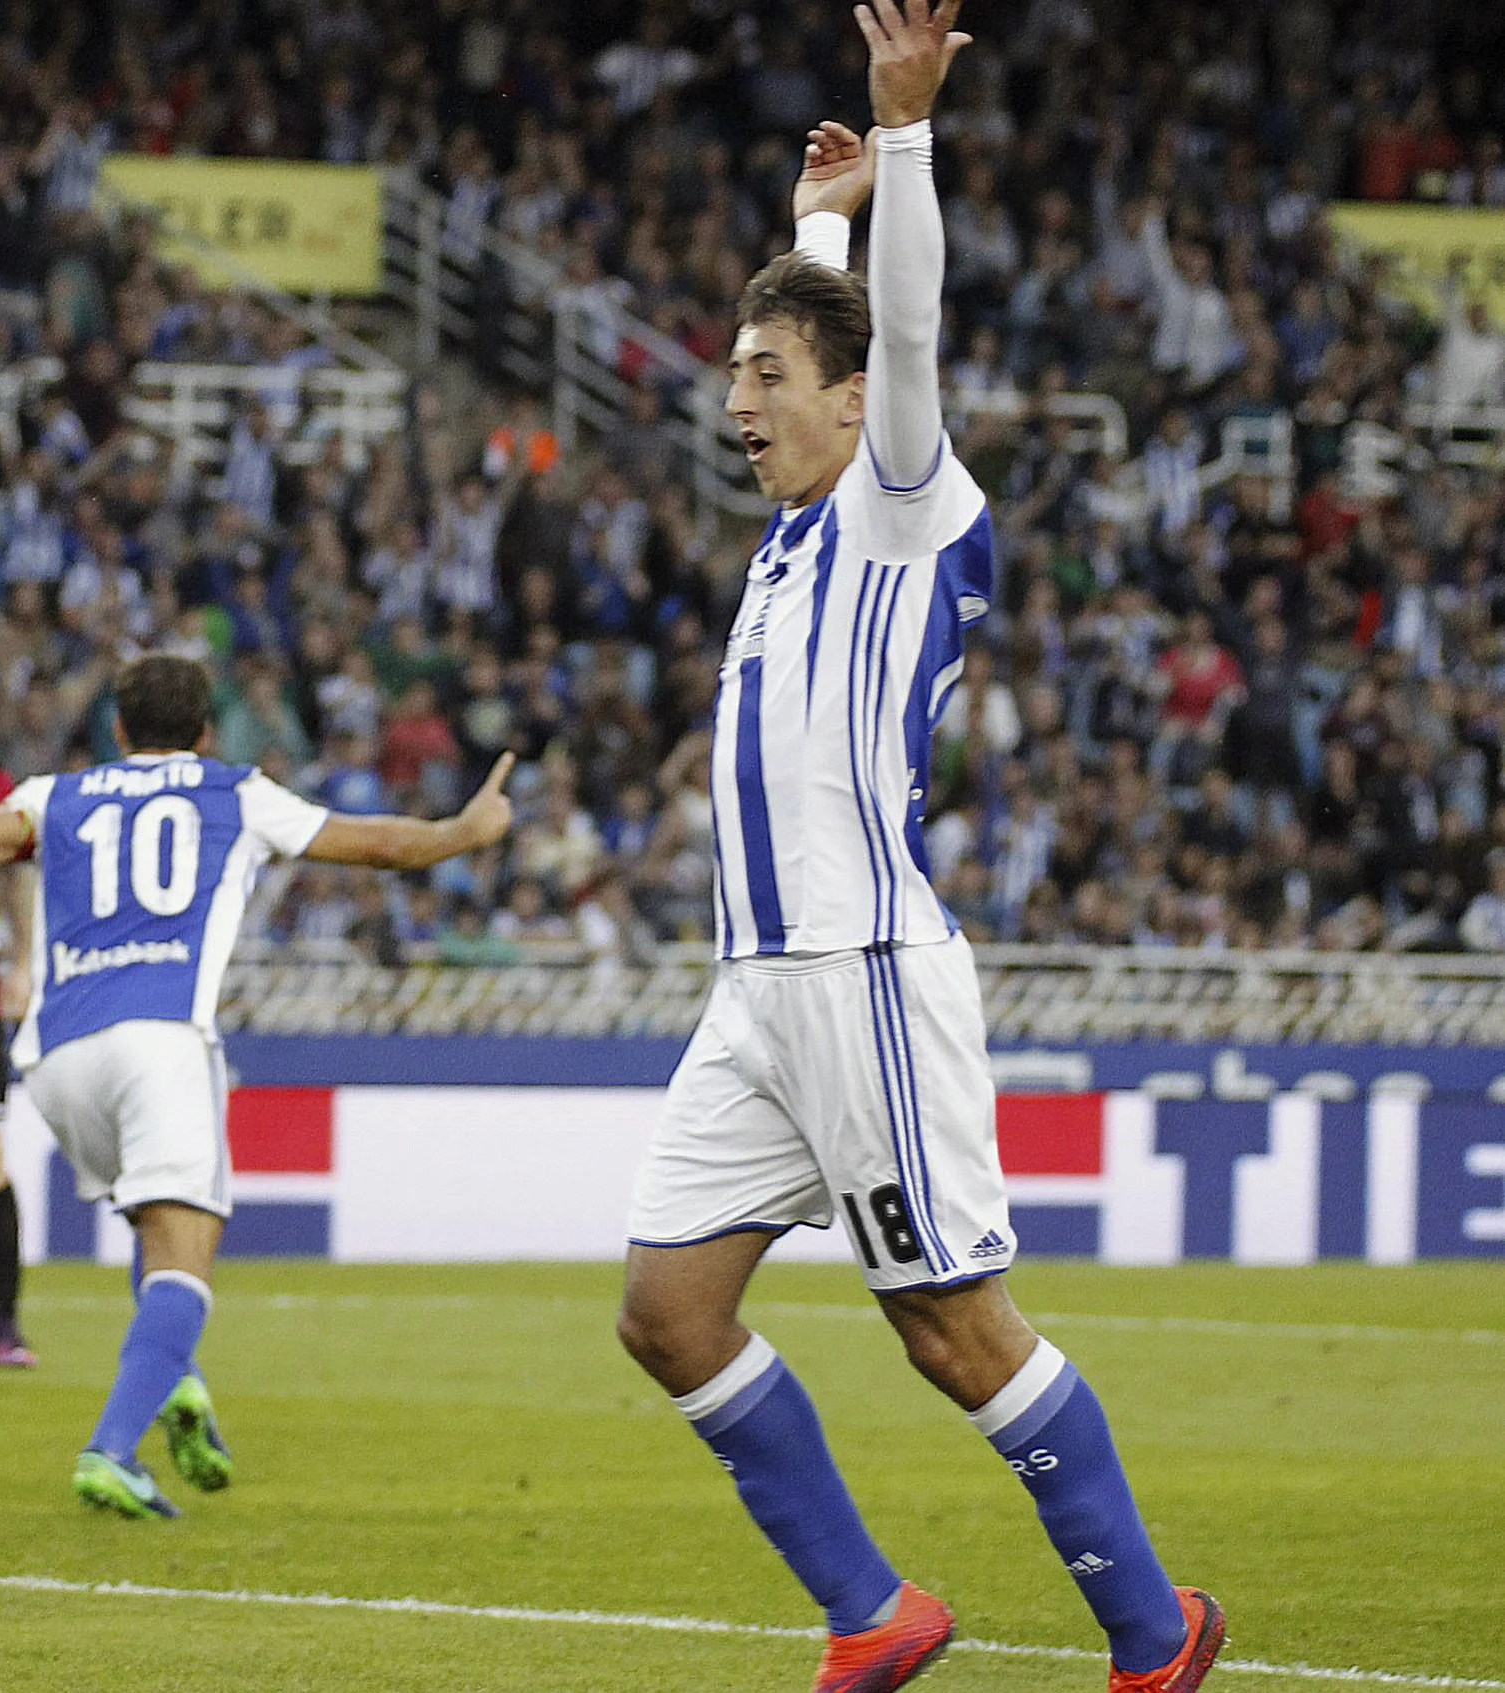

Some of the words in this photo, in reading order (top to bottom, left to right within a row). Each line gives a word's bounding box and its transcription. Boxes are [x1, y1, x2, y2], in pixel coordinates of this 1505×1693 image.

[76, 794, 202, 919] 10
[841, 1182, 921, 1268] 18
[1007, 1447, 1058, 1479] RS
